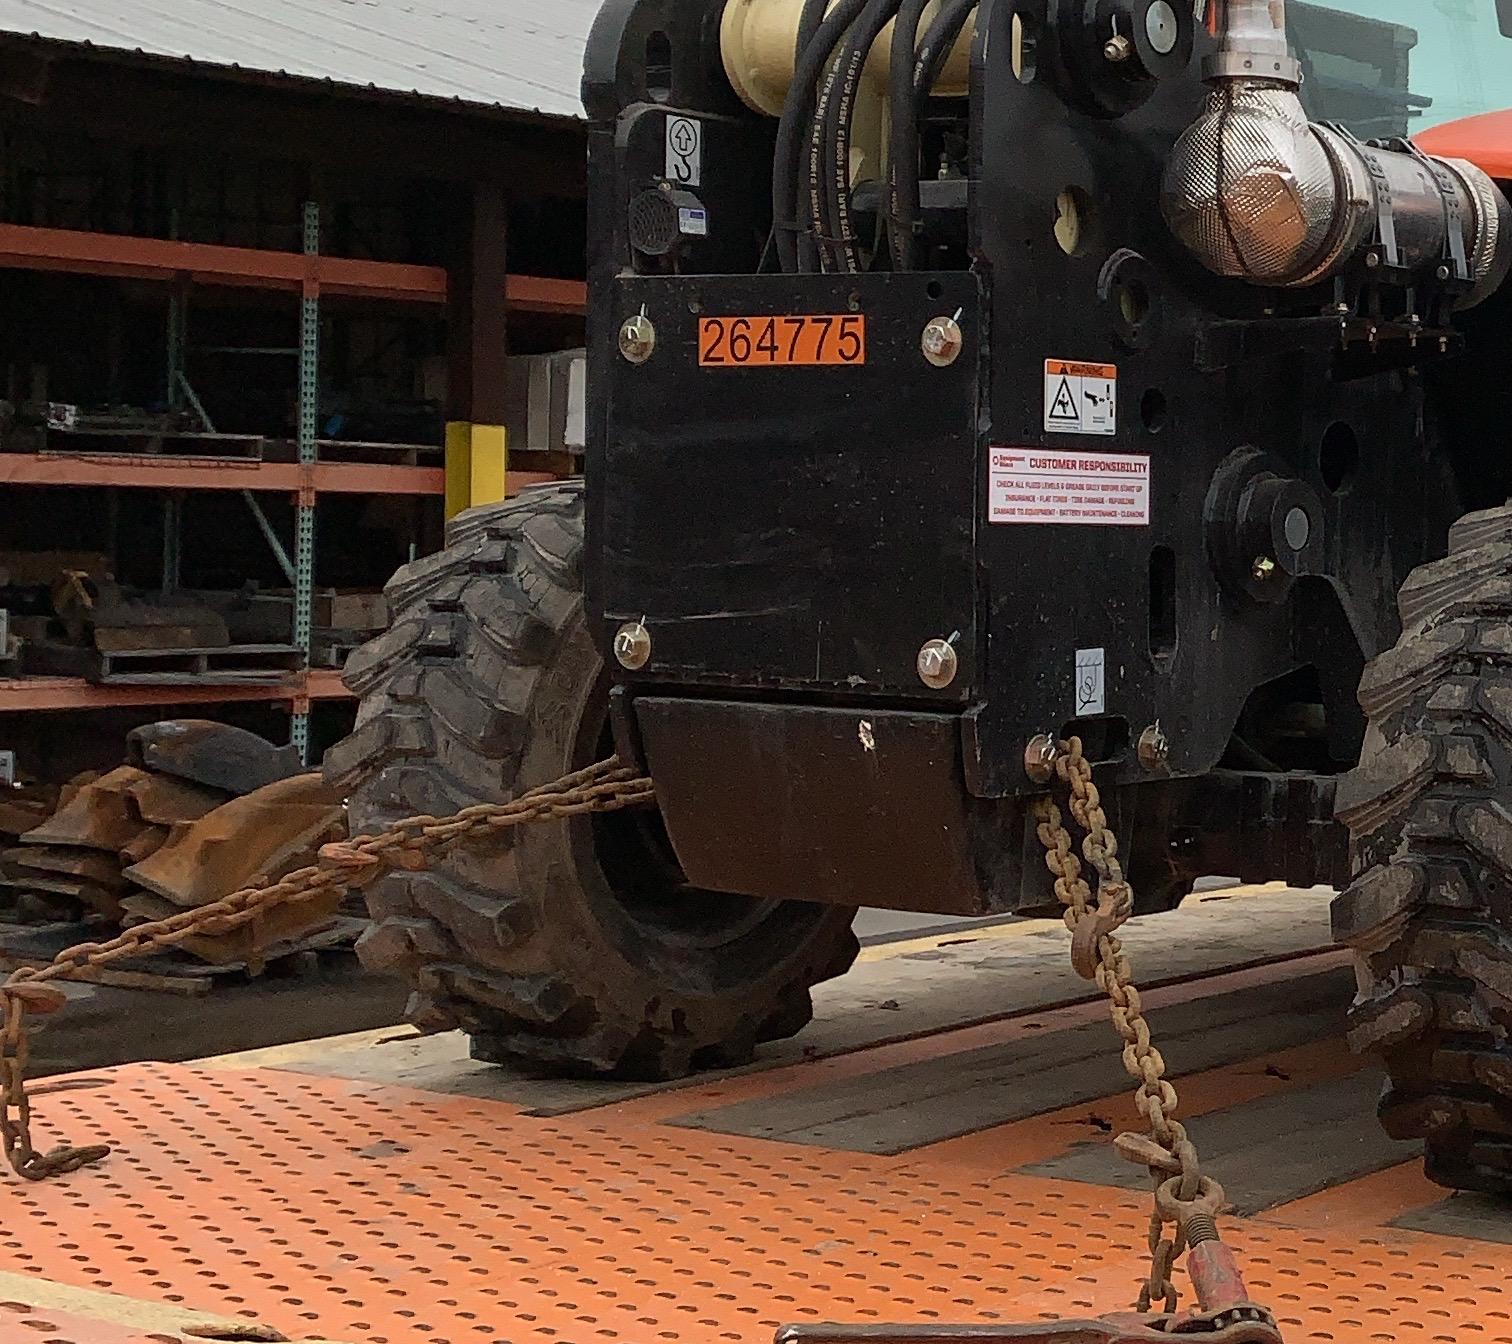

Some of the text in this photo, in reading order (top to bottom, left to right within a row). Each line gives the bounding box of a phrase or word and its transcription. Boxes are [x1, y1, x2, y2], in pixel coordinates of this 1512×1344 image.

[702, 316, 862, 364] 264775
[1029, 458, 1148, 474] CUSTOMER RESPONSIBILITY
